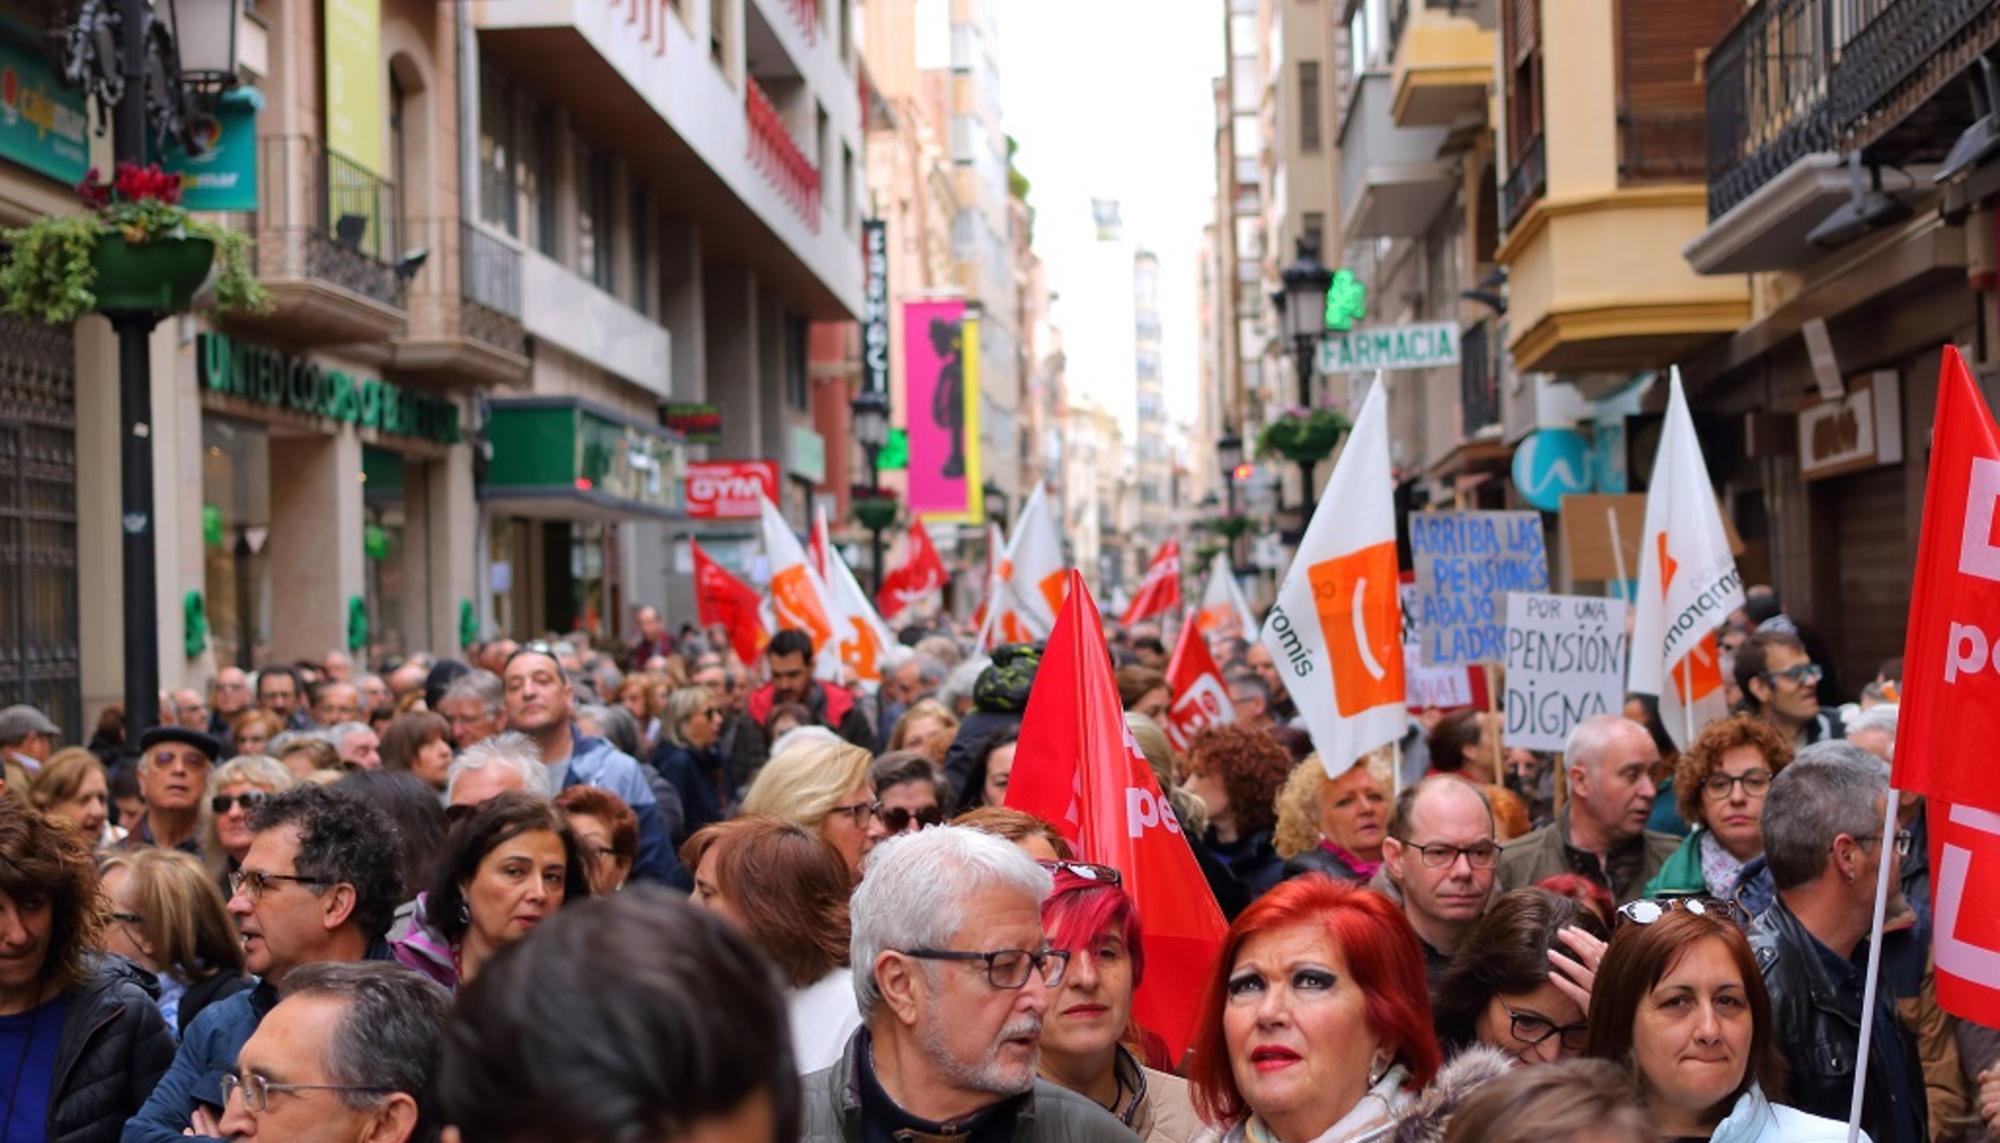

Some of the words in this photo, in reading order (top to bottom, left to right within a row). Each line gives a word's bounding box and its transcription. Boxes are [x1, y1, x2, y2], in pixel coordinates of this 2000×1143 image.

[865, 229, 888, 394] FARMACI
[1322, 329, 1454, 368] FARMACIA
[691, 477, 762, 500] GYM
[1506, 517, 1542, 555] LAS
[1432, 557, 1548, 594] PENSIONES
[1423, 594, 1495, 629] ABAJO
[1527, 598, 1561, 618] POR
[1574, 600, 1608, 621] UNA
